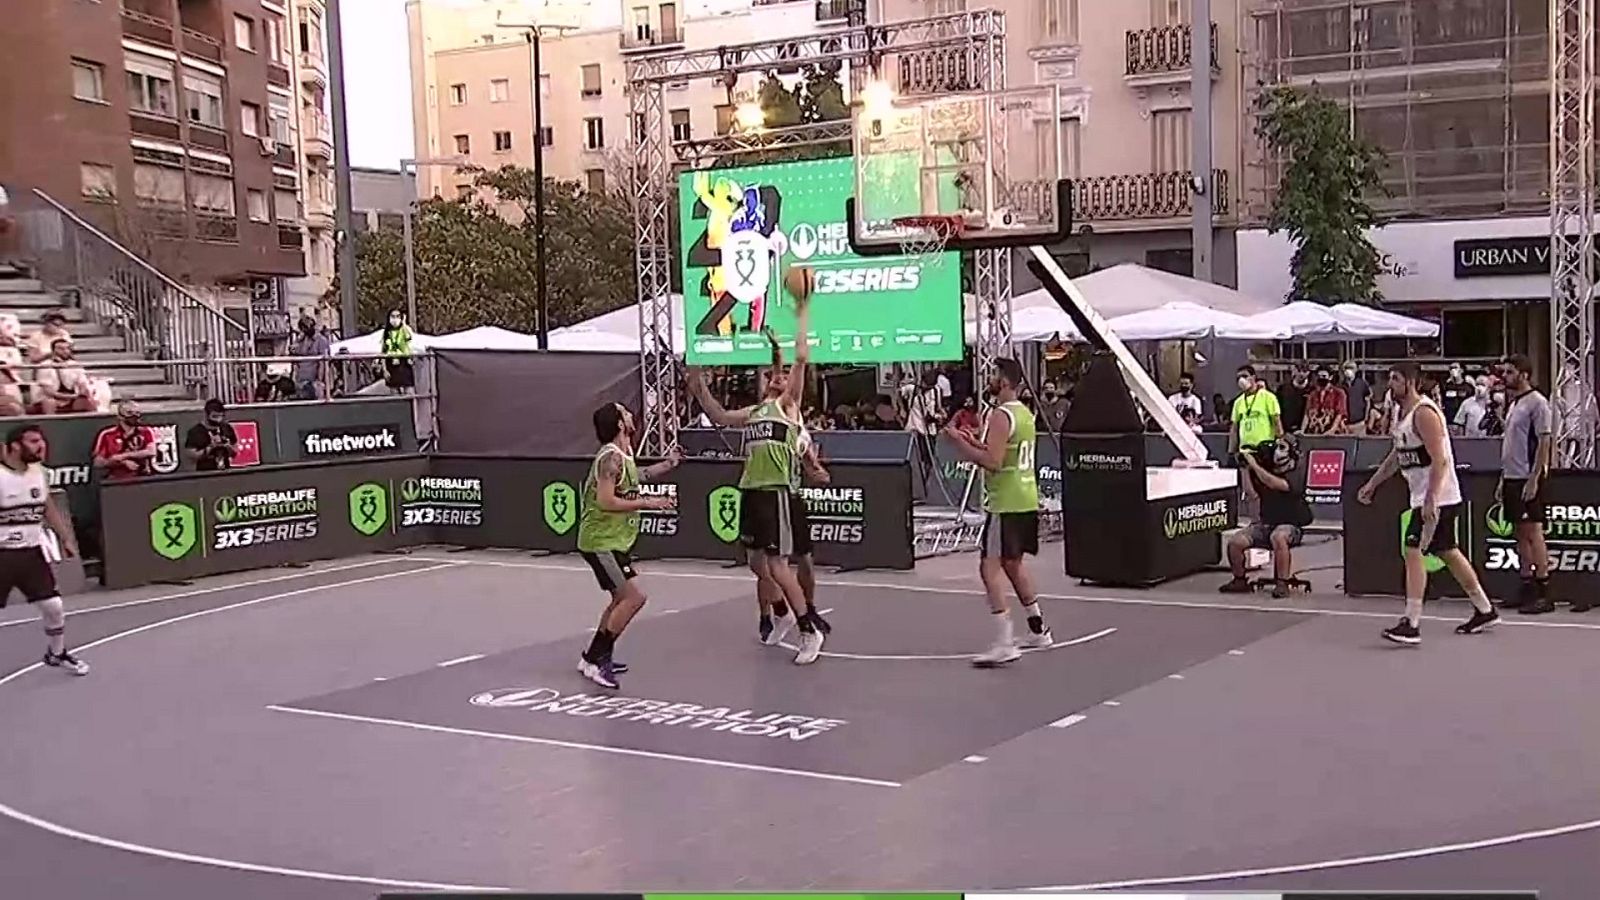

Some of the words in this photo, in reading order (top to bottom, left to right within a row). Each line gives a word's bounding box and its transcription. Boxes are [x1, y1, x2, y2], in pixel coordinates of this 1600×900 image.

[1460, 248, 1528, 267] URBAN
[1534, 246, 1550, 263] V
[253, 314, 291, 334] PARKING
[305, 428, 396, 453] finetwork
[420, 477, 481, 490] HERBALIFE
[237, 488, 317, 507] HERBALIFE
[421, 489, 482, 501] NUTRITION
[238, 500, 318, 519] NUTRITION
[402, 508, 482, 526] 3X3SERIES
[1178, 500, 1228, 520] HERBALIFE
[1178, 512, 1228, 534] NUTRITION
[214, 521, 318, 550] 3X3SERIES
[528, 701, 824, 741] NUTRITION
[561, 693, 849, 731] HERBALIFE
